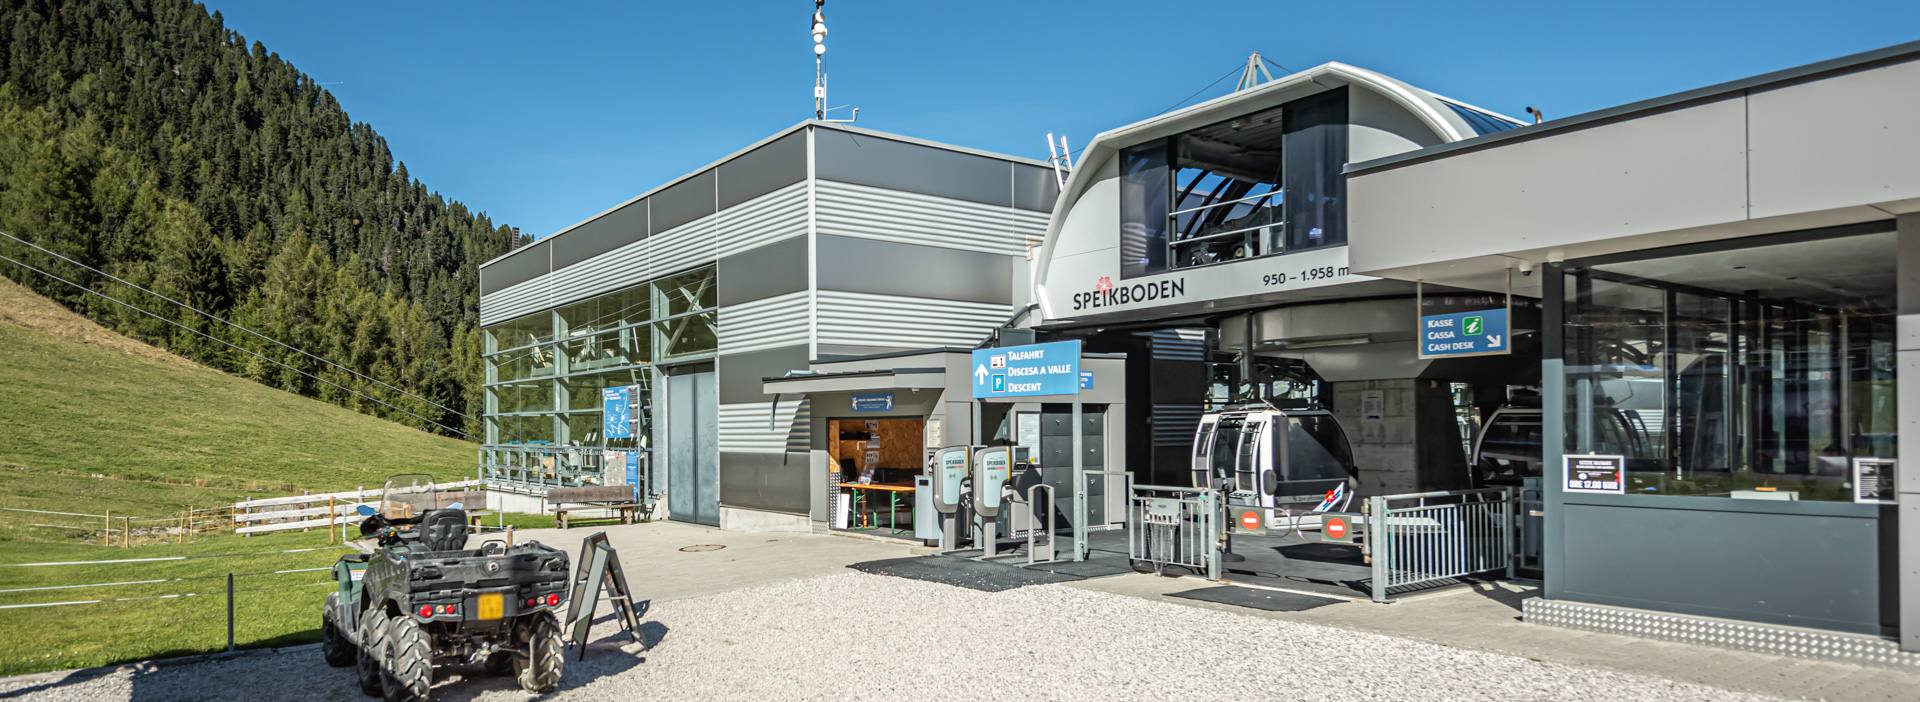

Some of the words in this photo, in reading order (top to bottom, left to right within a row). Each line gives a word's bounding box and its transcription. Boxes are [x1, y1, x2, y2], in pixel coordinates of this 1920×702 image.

[1263, 273, 1286, 286] 950
[1301, 266, 1334, 281] 1.958
[1338, 267, 1349, 277] m
[1073, 278, 1185, 310] SPEIKBODEN
[1427, 319, 1454, 329] KASSE
[1427, 331, 1456, 340] CASSA
[1427, 343, 1451, 352] CASH
[1453, 341, 1475, 350] DESK
[1007, 350, 1045, 360] TALFAHRT
[1007, 366, 1039, 377] DISCESA
[1040, 365, 1047, 375] A
[1048, 363, 1072, 374] VALLE
[1007, 382, 1042, 393] DESCENT
